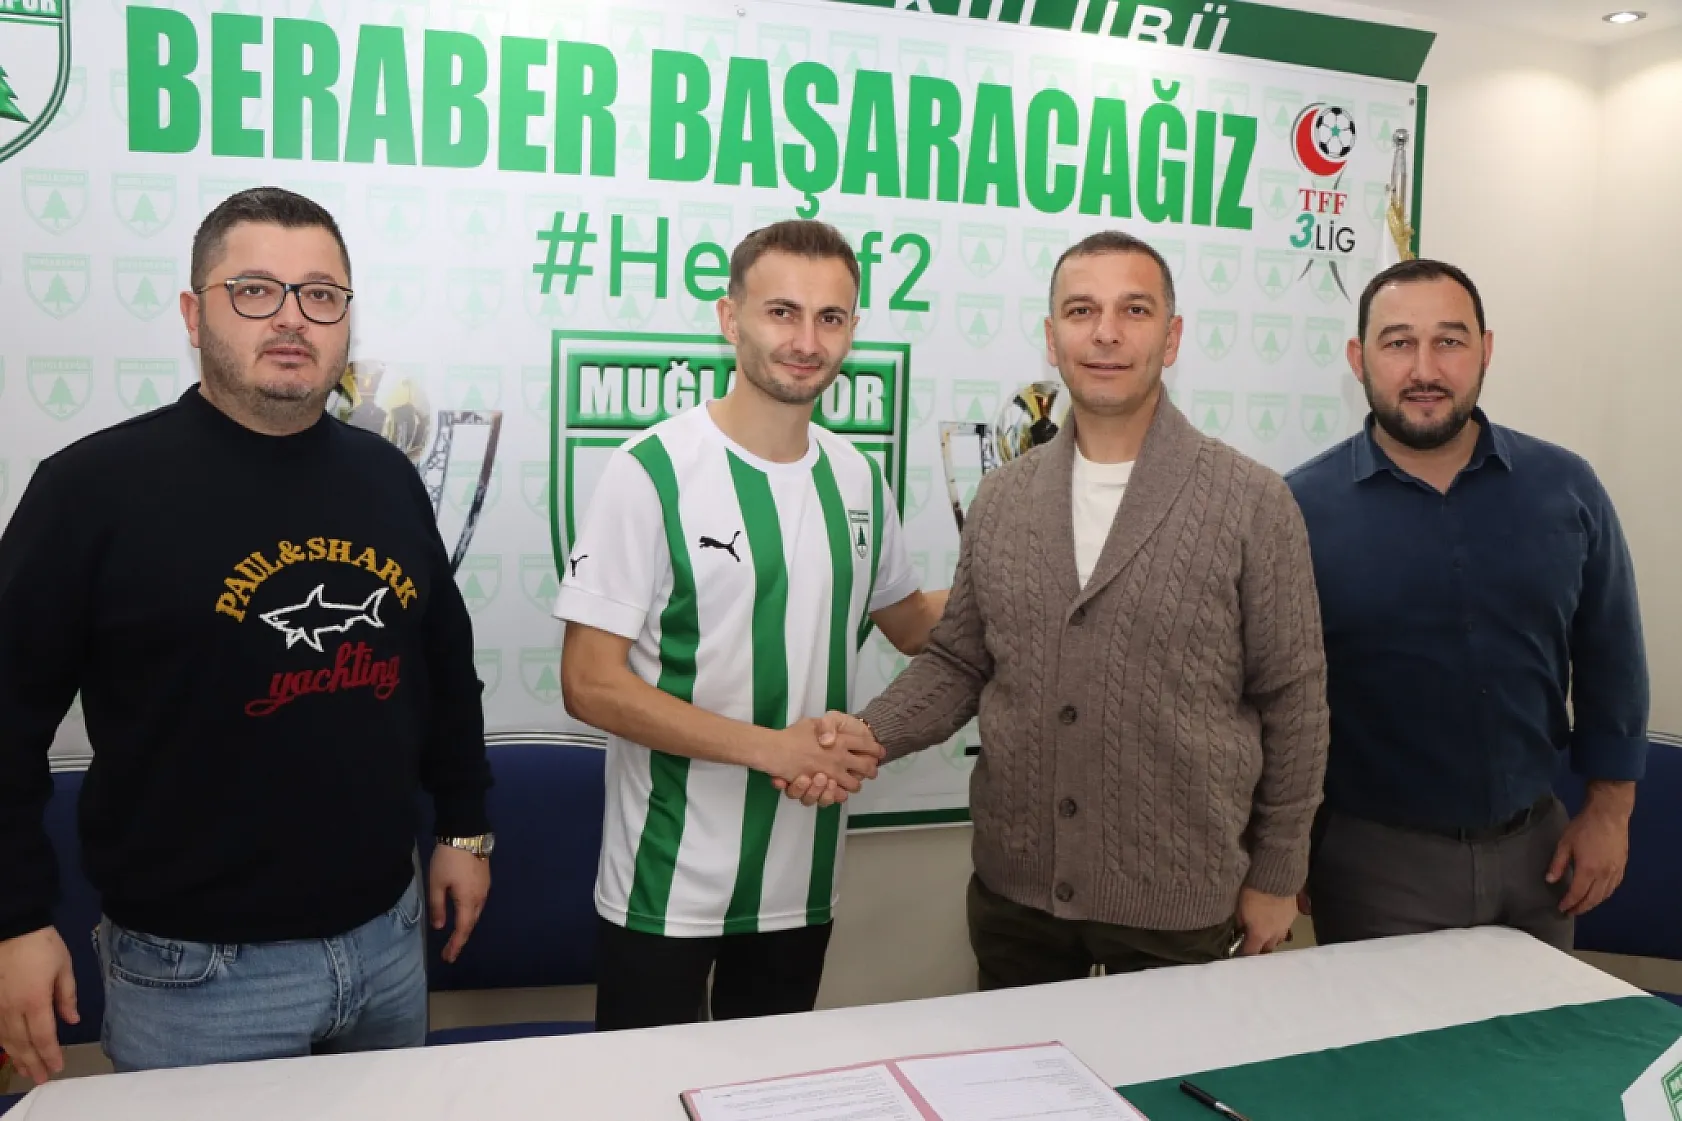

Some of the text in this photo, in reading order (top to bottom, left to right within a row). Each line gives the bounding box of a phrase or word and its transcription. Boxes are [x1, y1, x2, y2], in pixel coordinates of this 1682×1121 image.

[126, 5, 1257, 230] BERABER BAŞARACAĞIZ
[1297, 187, 1348, 214] TFF
[532, 210, 931, 313] #Hef2
[214, 536, 418, 623] PAUL&SHARK
[244, 641, 400, 717] yachting
